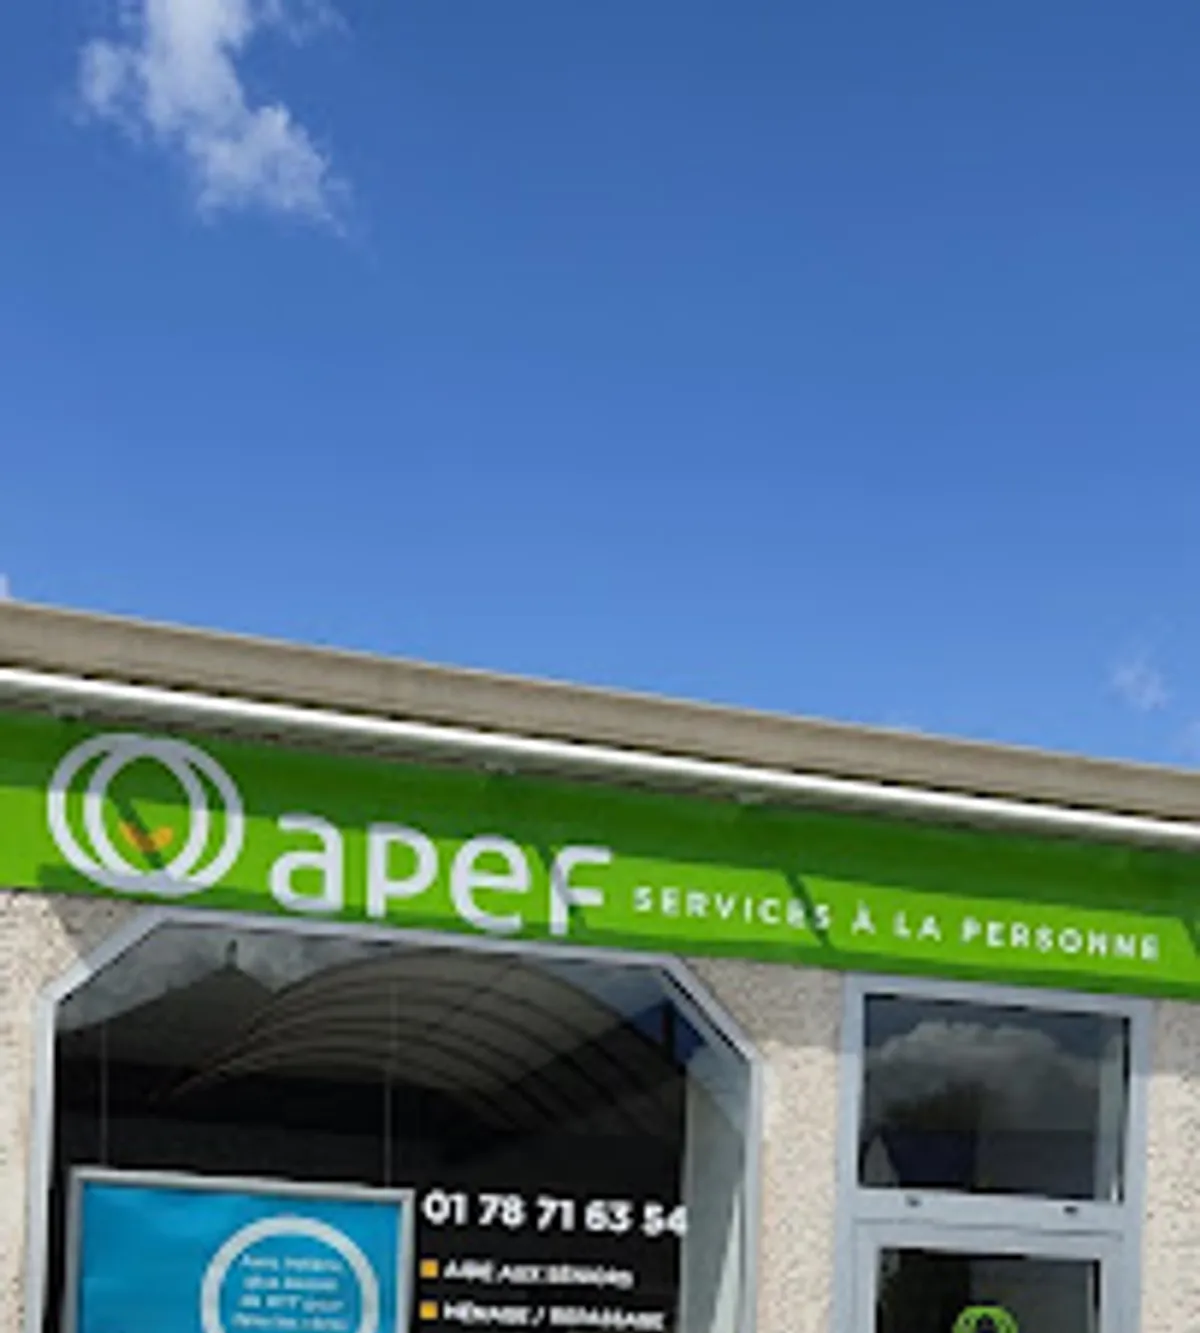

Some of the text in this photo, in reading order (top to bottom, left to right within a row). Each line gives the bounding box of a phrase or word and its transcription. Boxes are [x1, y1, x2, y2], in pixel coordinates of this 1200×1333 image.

[633, 886, 1160, 962] SERVICES À LA PERSONNE
[422, 1189, 688, 1237] 01 78 71 63 54
